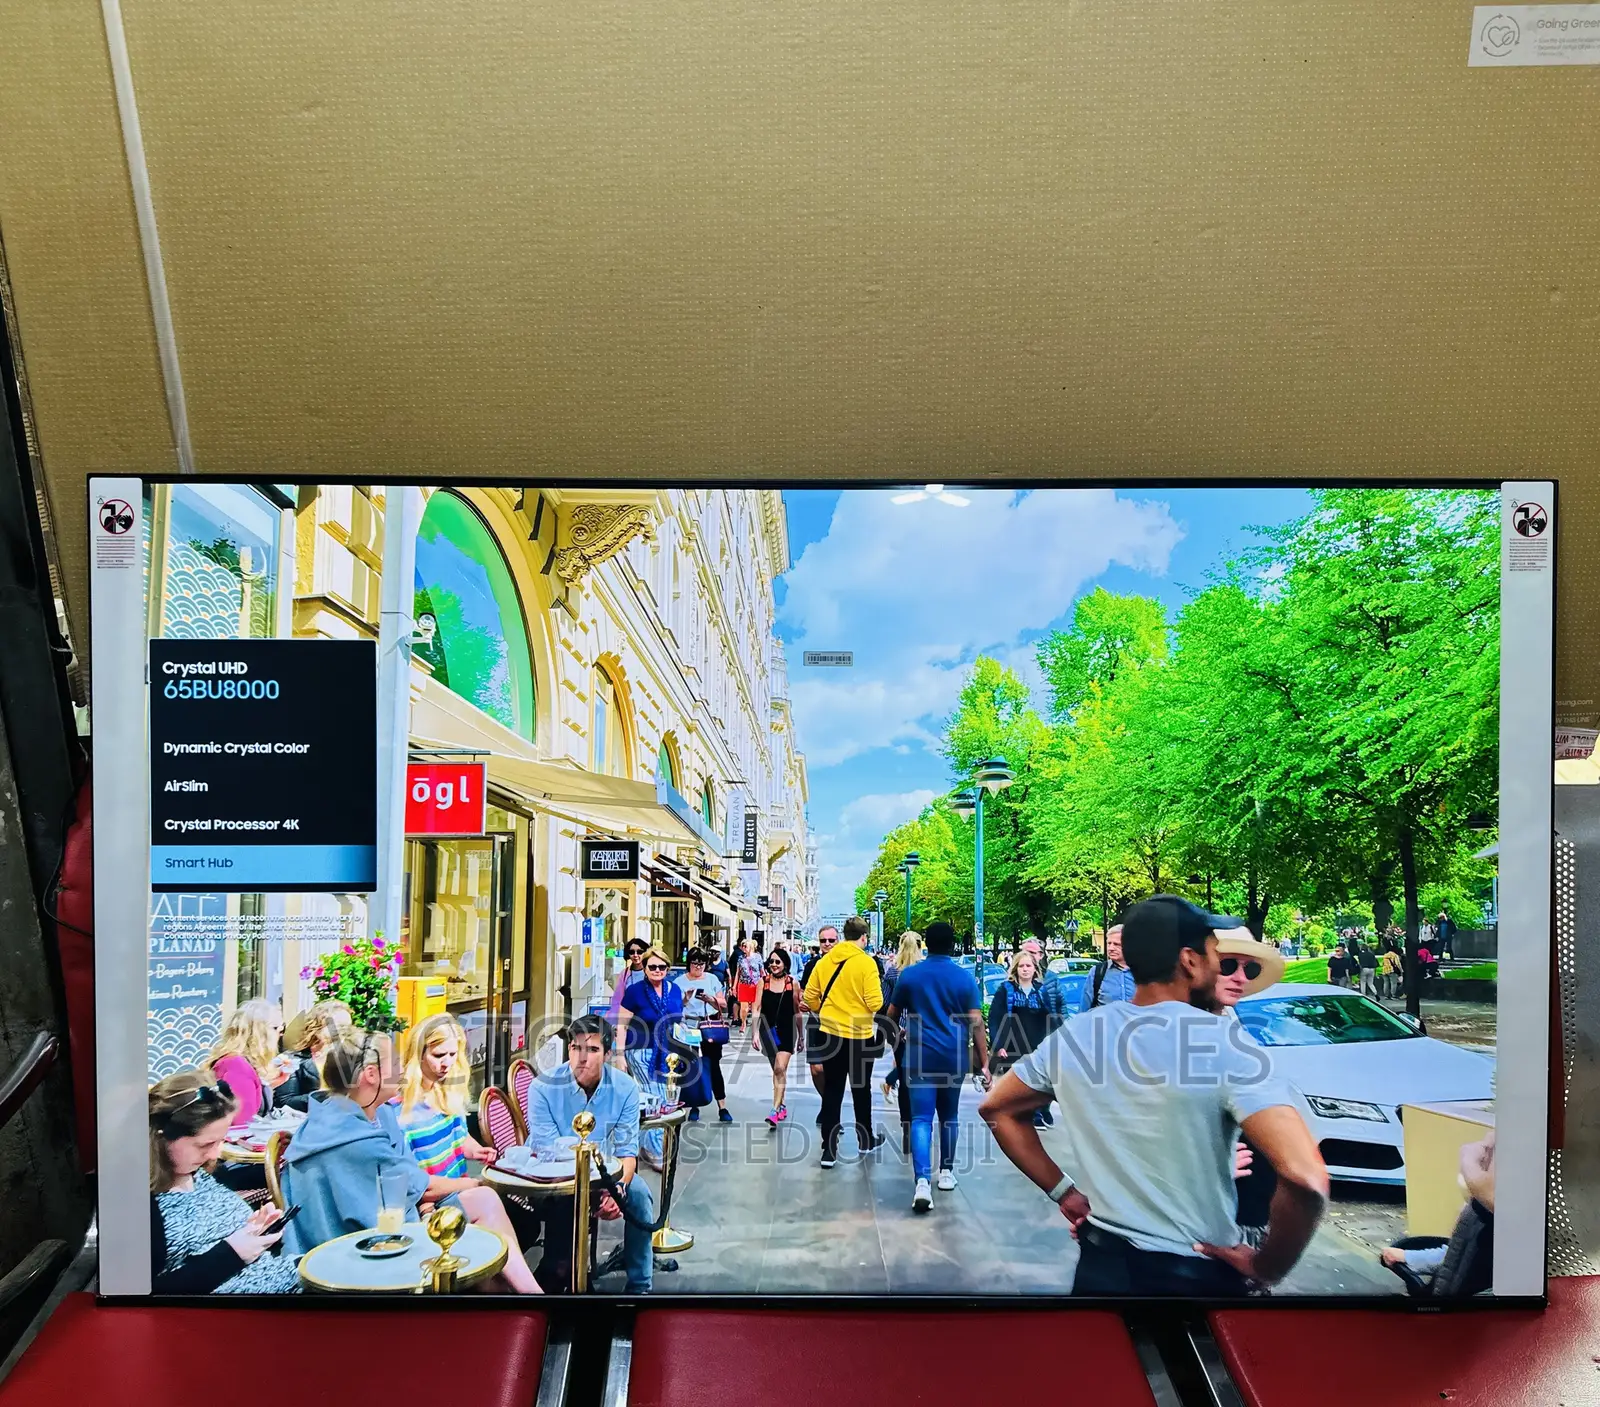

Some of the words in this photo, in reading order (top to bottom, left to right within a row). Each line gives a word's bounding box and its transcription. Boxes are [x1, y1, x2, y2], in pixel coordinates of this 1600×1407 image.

[1536, 18, 1568, 32] Going
[162, 661, 216, 677] Crystal
[218, 662, 248, 675] UHD
[163, 679, 280, 700] 65BU8000
[163, 741, 222, 756] Dynamic
[224, 742, 272, 756] Crystal
[274, 742, 310, 754] Color
[164, 779, 209, 792] AirSlim
[164, 818, 212, 833] Crystal
[213, 819, 280, 830] Processor
[282, 819, 300, 830] 4K
[731, 796, 740, 844] TREVIAN
[745, 819, 755, 858] Siluetti
[165, 857, 205, 868] Smart
[208, 857, 234, 868] Hub
[230, 914, 245, 922] and
